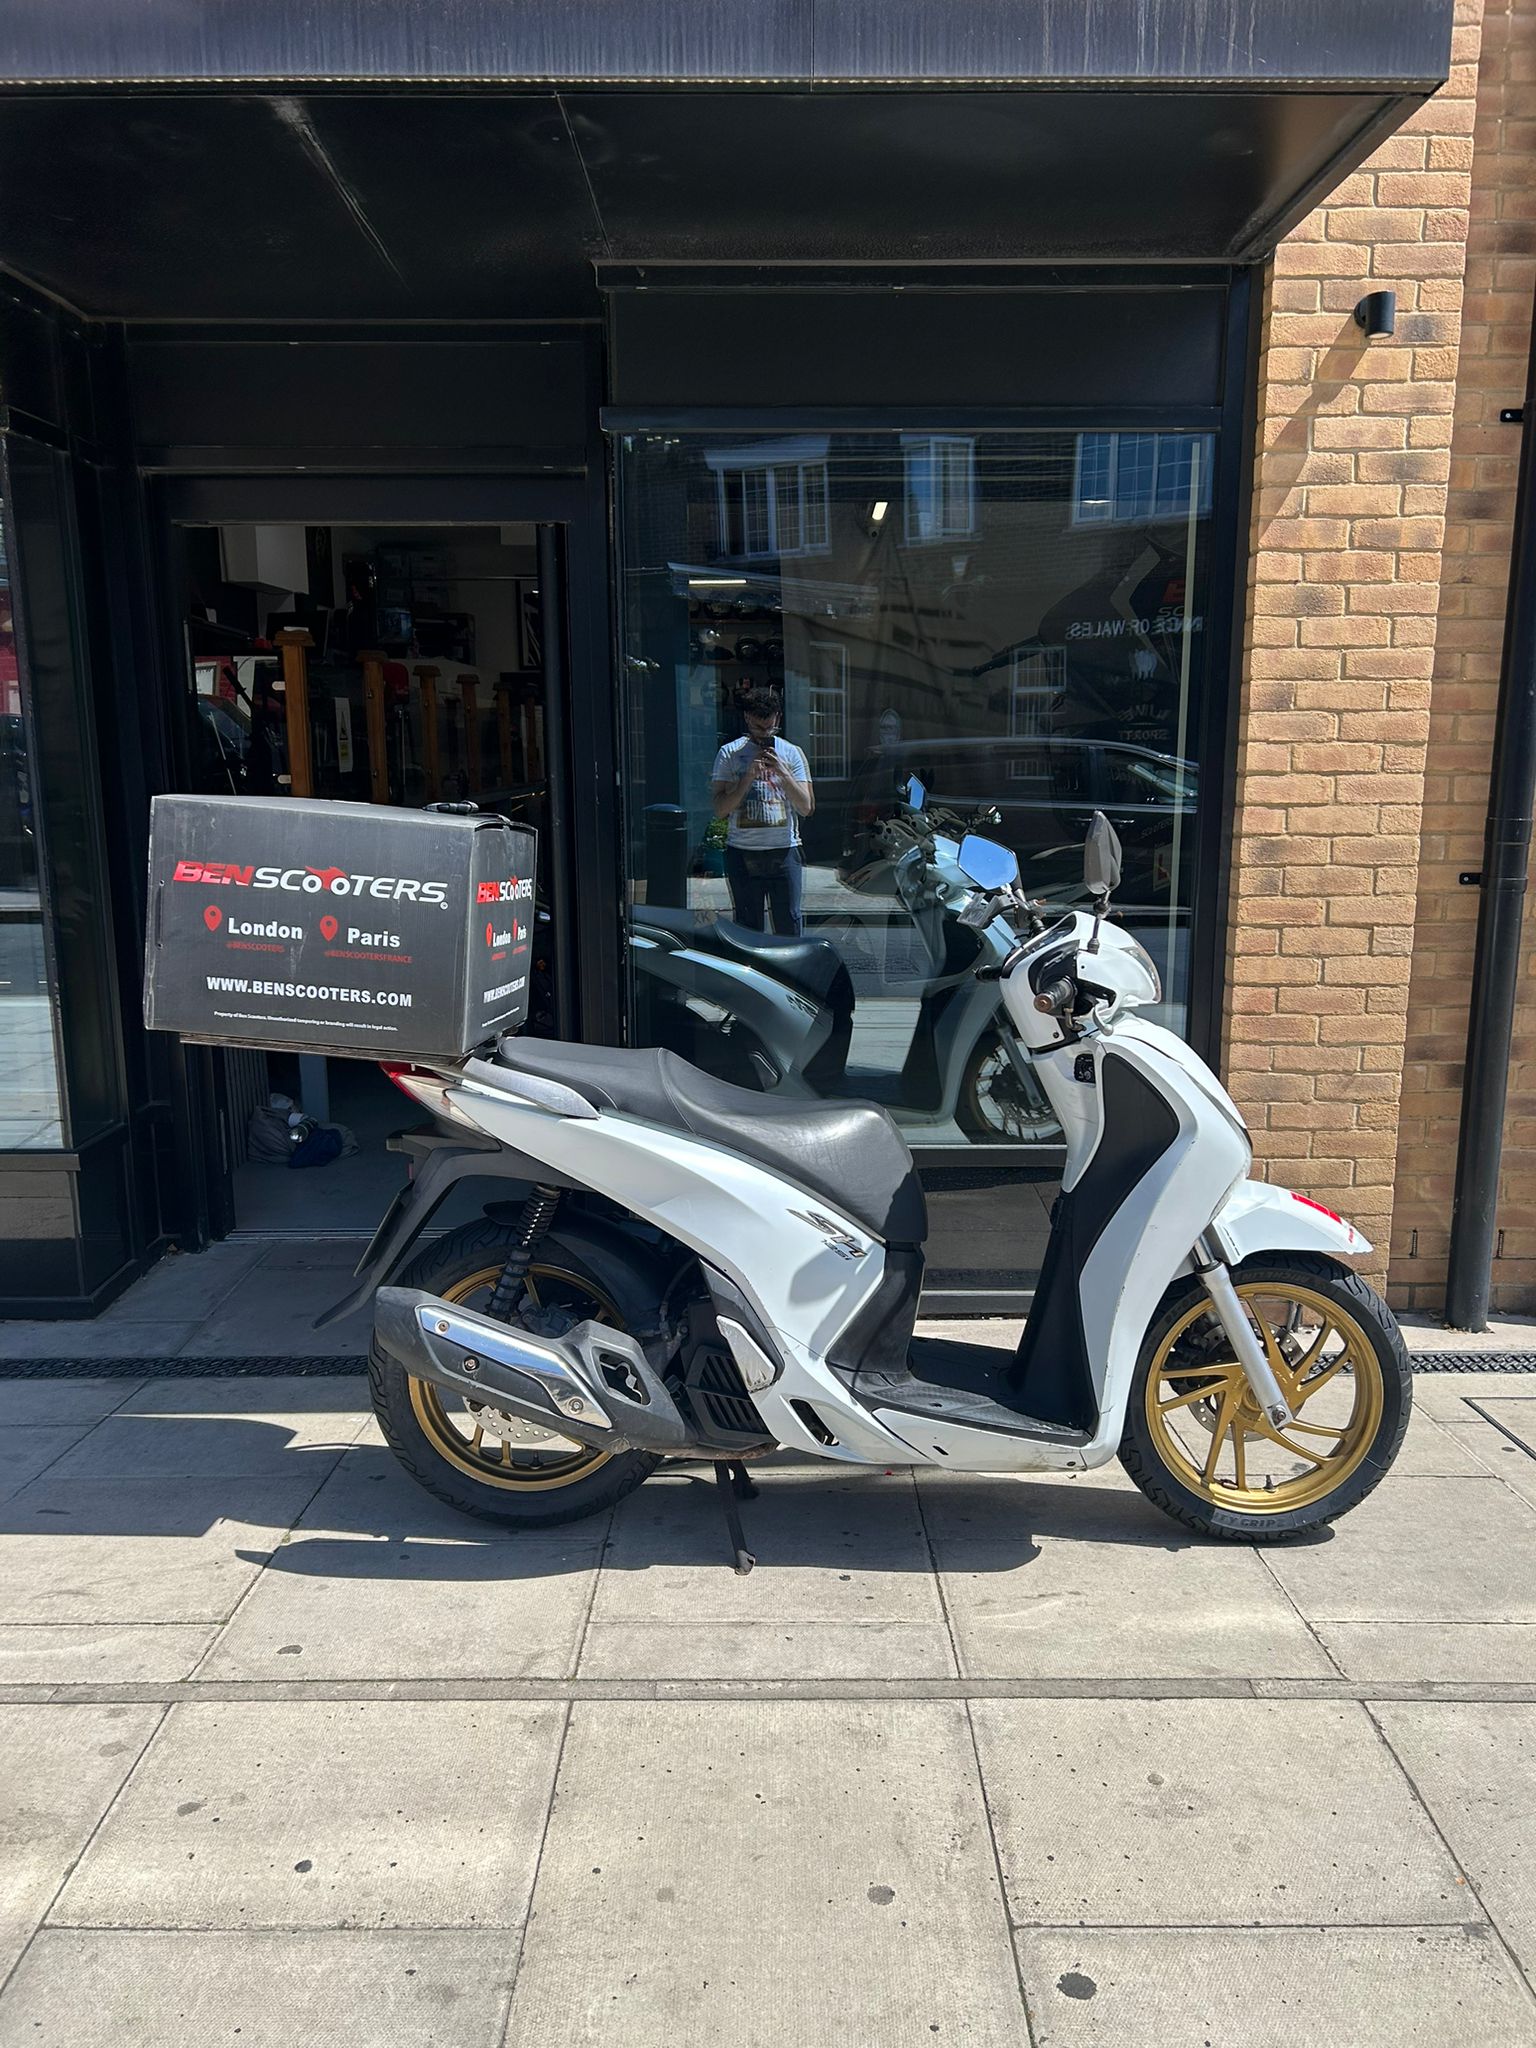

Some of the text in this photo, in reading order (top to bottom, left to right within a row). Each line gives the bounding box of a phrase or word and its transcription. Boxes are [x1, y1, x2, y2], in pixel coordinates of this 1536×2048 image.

[172, 861, 449, 904] BENSCOOTERS
[228, 917, 303, 940] London
[347, 927, 401, 948] Paris
[493, 930, 511, 948] London
[206, 976, 412, 1008] WWW.BENSCOOTERS.COM
[1240, 1518, 1276, 1528] GRIP
